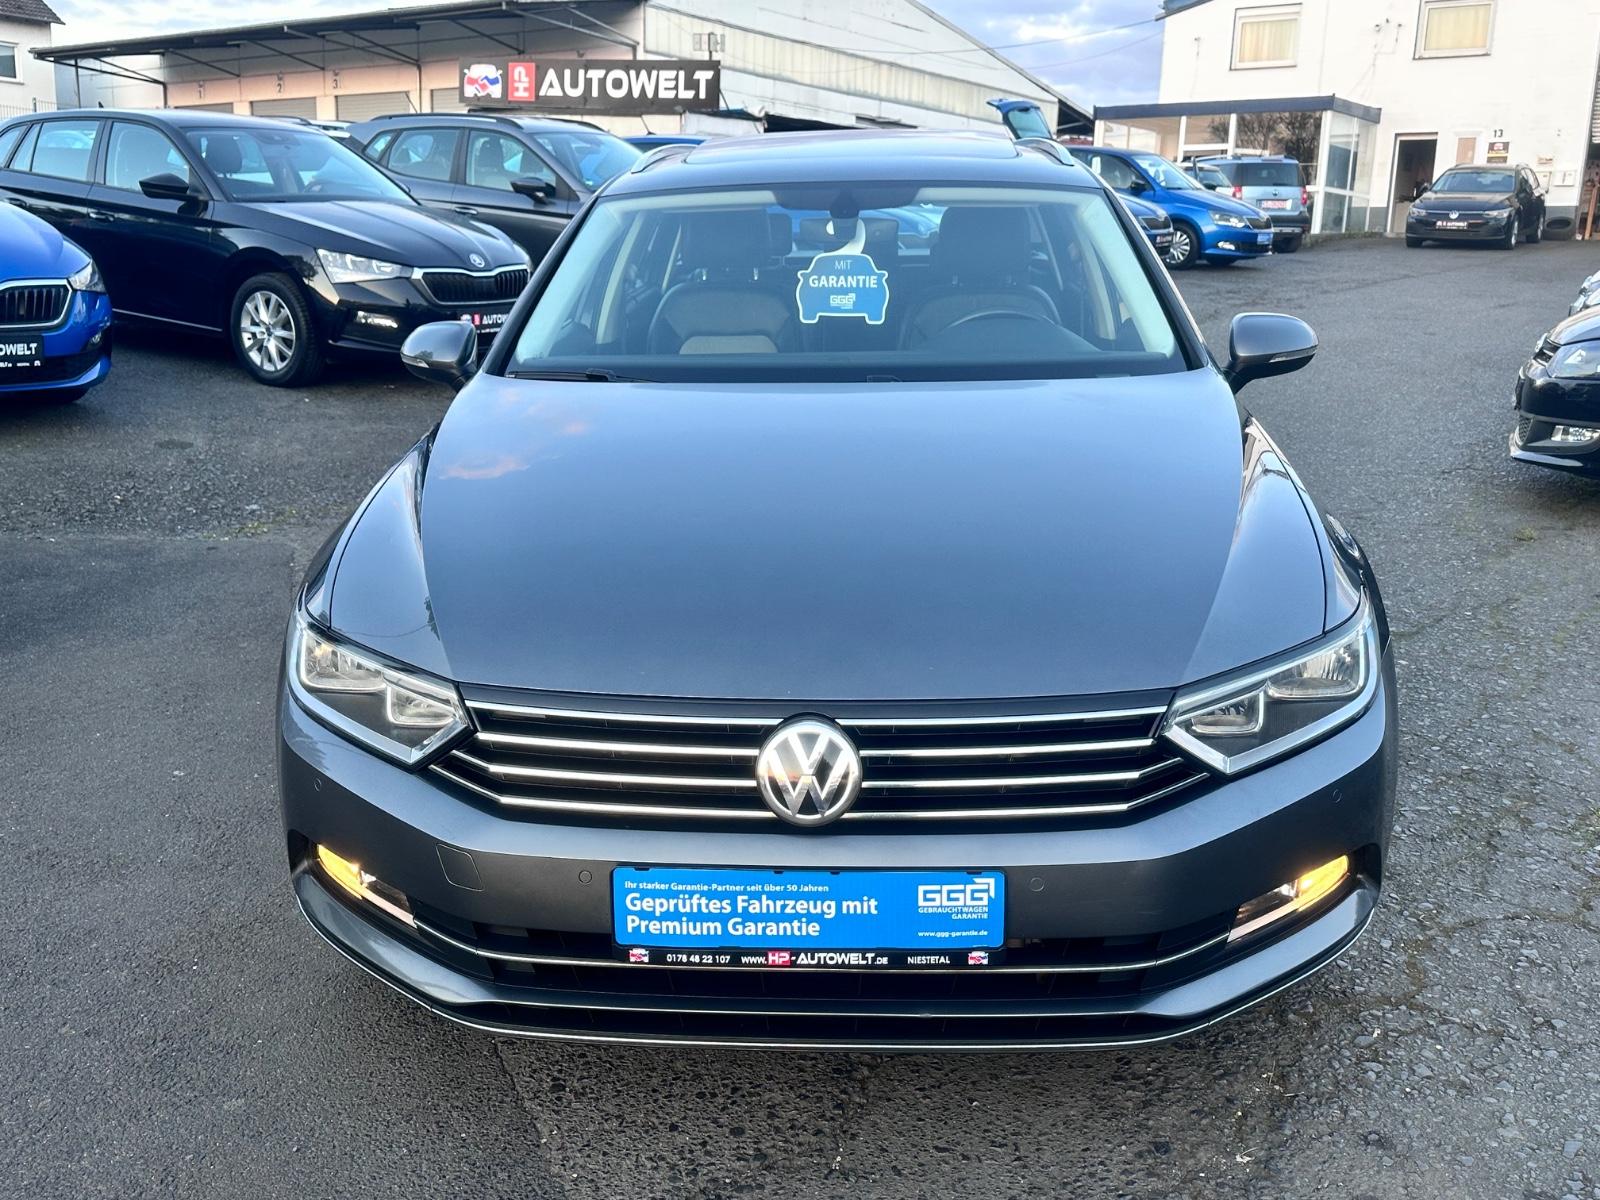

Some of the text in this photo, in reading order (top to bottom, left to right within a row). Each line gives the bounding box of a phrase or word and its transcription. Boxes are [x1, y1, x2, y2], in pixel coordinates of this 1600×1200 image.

[539, 68, 714, 99] AUTOWELT
[1493, 128, 1504, 138] 13
[834, 260, 852, 270] MIT
[809, 275, 878, 288] GARANTIE
[624, 881, 829, 892] Ihr starker Garantie-Partner seit über 50 Jahren
[918, 884, 988, 906] GGG
[625, 893, 878, 919] Geprüftes Fahrzeug mit
[626, 915, 820, 936] Premium Garantie
[918, 930, 988, 938] www.ggg-garantie.de
[702, 955, 714, 964] 22
[716, 955, 731, 964] 107
[907, 956, 950, 964] NIESTETAL
